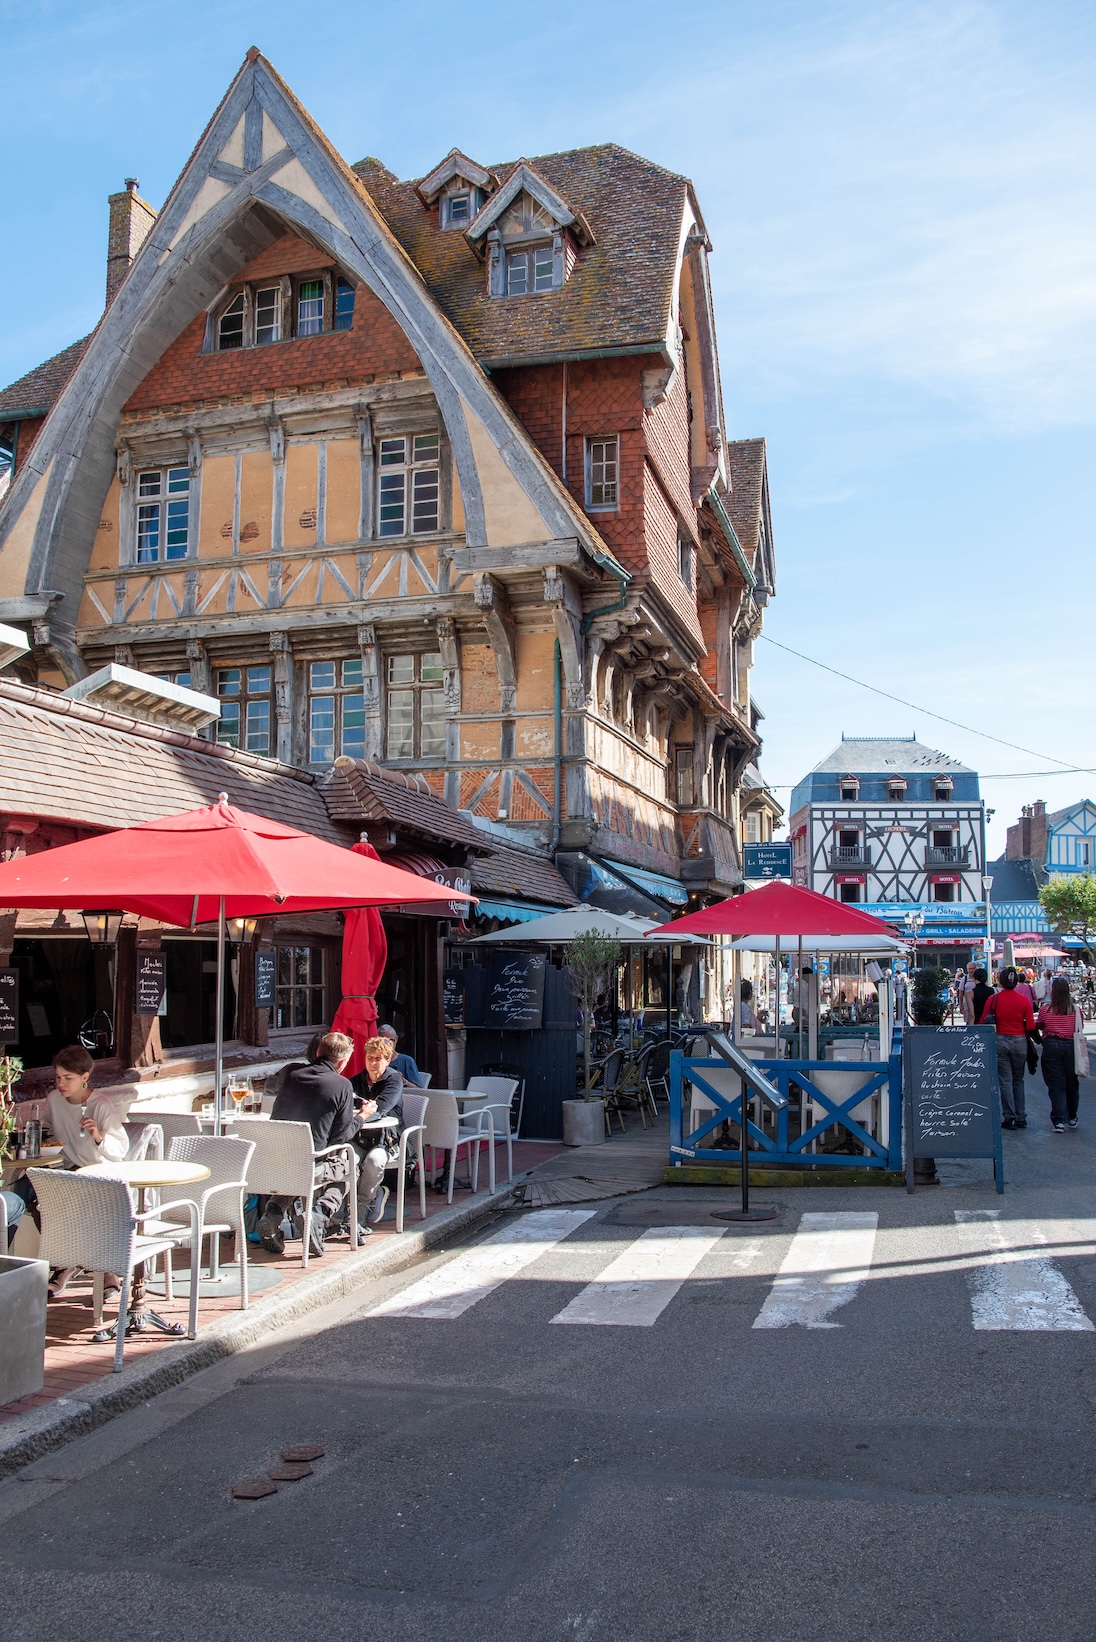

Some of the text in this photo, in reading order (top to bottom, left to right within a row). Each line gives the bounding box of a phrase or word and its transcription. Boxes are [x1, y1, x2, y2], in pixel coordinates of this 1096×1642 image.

[924, 904, 934, 913] du
[936, 905, 963, 916] Bateau
[924, 1051, 957, 1065] Formule
[922, 1067, 947, 1077] Frites
[920, 1119, 947, 1127] beurre
